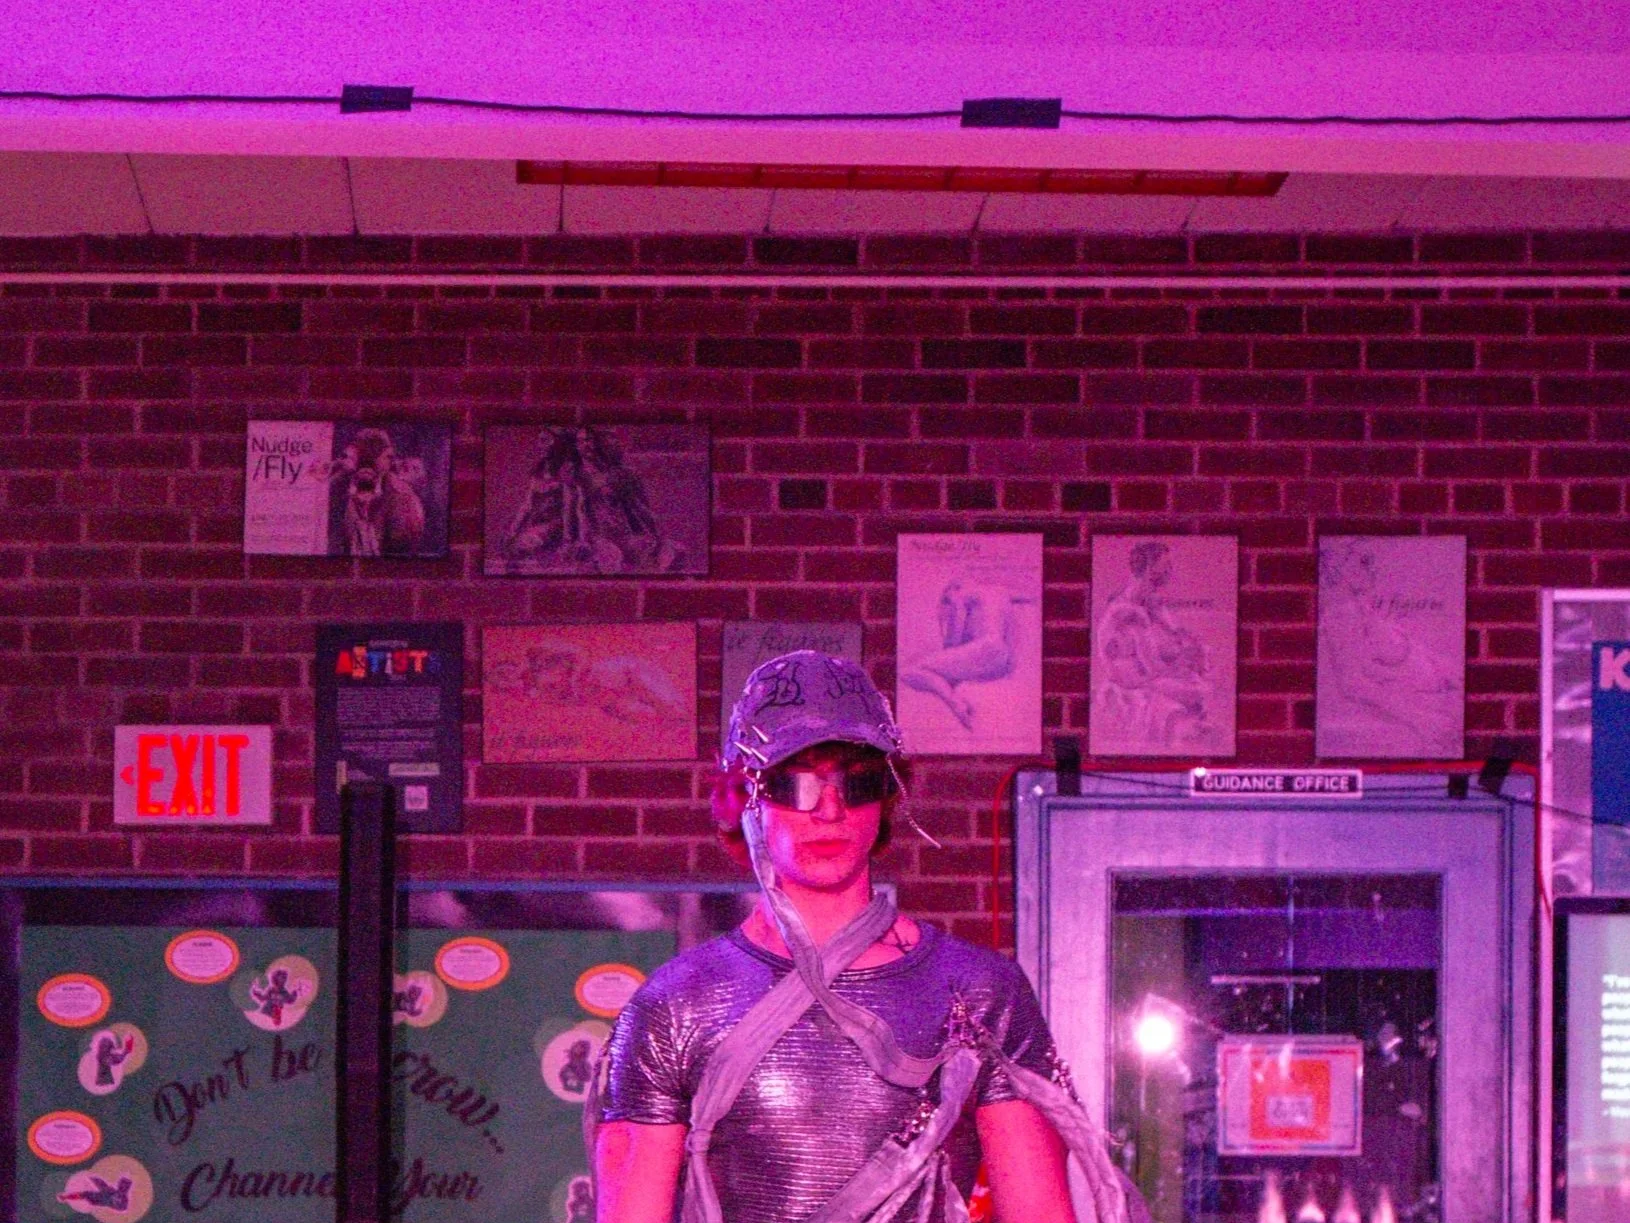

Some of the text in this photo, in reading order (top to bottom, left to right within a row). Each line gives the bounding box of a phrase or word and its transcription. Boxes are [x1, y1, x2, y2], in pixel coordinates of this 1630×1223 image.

[251, 436, 313, 457] Nudge
[252, 455, 303, 485] /Fly
[136, 734, 250, 817] EXIT
[1203, 775, 1349, 791] GUIDANCE OFFICE
[271, 1034, 322, 1083] be
[179, 1158, 338, 1213] Channe
